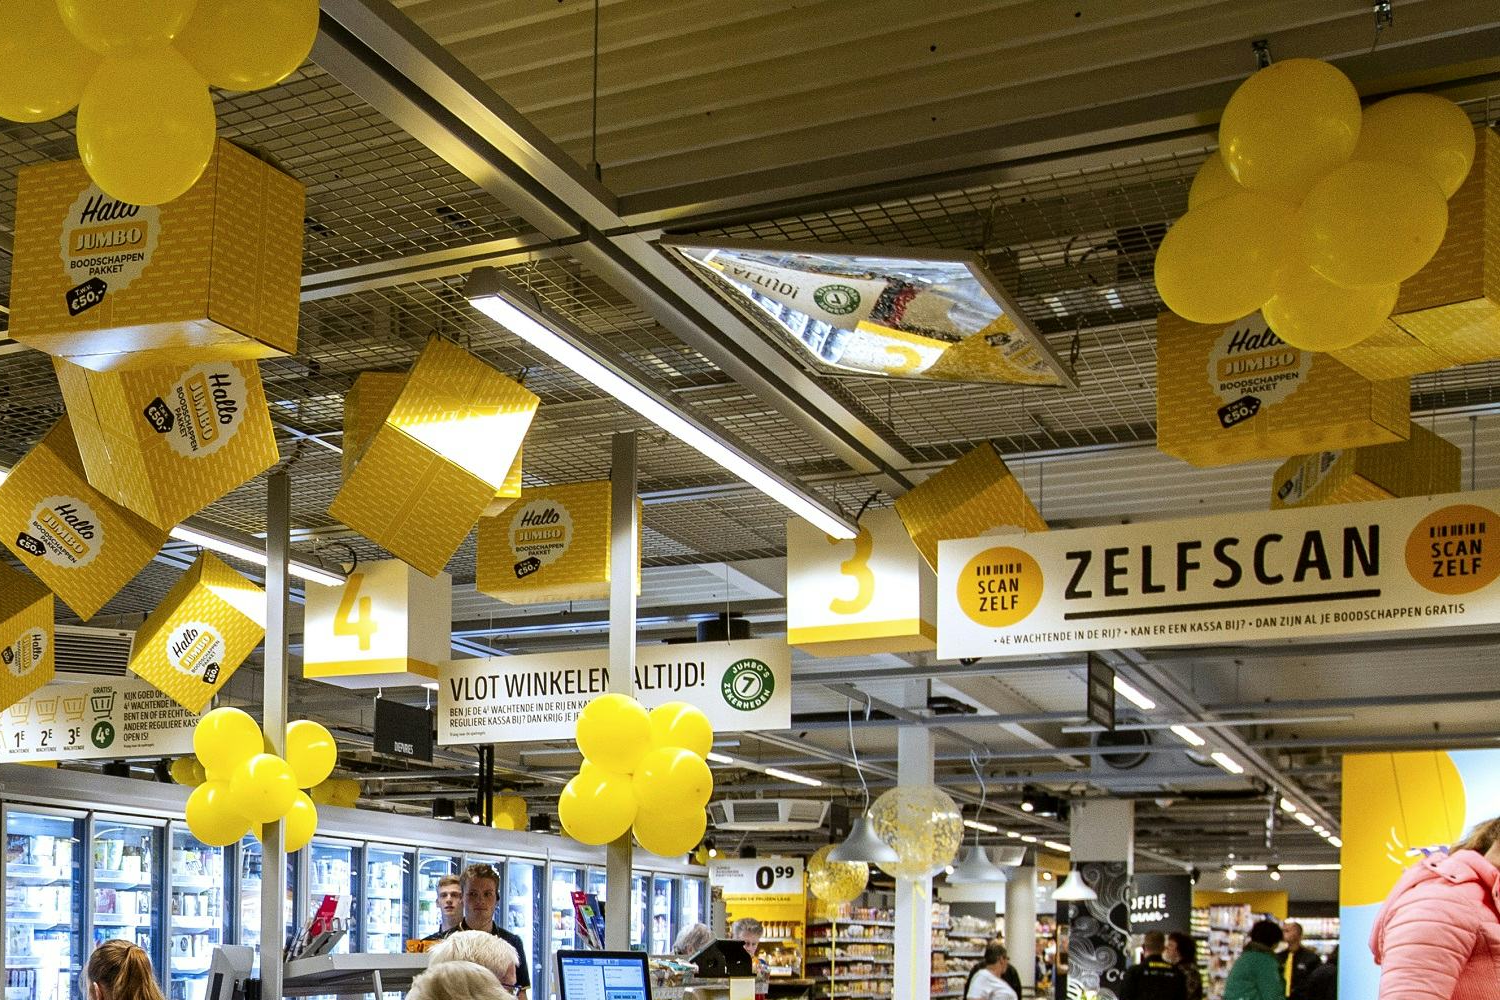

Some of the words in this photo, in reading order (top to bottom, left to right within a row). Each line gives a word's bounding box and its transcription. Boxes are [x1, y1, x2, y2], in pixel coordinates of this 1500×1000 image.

[80, 194, 140, 224] Hallo
[75, 227, 143, 251] JUMBO
[70, 252, 144, 269] BOODSCHAPPEN
[89, 264, 124, 276] PAKKET
[71, 290, 103, 310] €50,-
[1226, 353, 1296, 376] JUMBO
[1220, 371, 1299, 391] BOODSCHAPPEN
[1241, 383, 1277, 394] PAKKET
[209, 373, 238, 425] Hallo
[148, 407, 167, 430] €50,-
[176, 386, 198, 452] BOODSCHAPPEN
[189, 382, 213, 440] JUMBO
[1224, 405, 1257, 423] €50,-
[175, 408, 187, 438] PAKKET
[54, 504, 94, 539] Hallo
[521, 508, 560, 527] Hallo
[32, 521, 77, 563] BOODSCHAPPEN
[42, 512, 84, 553] JUMBO
[517, 529, 562, 542] JUMBO
[41, 536, 62, 556] PAKKET
[516, 543, 564, 552] BOODSCHAPPEN
[1431, 539, 1483, 559] SCAN
[826, 525, 875, 615] 3
[1064, 524, 1380, 600] ZELFSCAN
[1433, 558, 1482, 578] ZELF
[978, 578, 1020, 595] SCAN
[334, 573, 377, 651] 4
[979, 594, 1020, 612] ZELF
[1000, 635, 1011, 645] 4E
[1013, 631, 1071, 644] WACHTENDE
[1074, 630, 1084, 640] IN
[1087, 629, 1099, 639] DE
[1102, 628, 1121, 639] RIJ?
[1131, 626, 1150, 636] KAN
[1153, 625, 1165, 635] ER
[1168, 623, 1187, 634] EEN
[1190, 621, 1223, 632] KASSA
[1225, 619, 1246, 631] BIJ?
[1256, 617, 1277, 628] DAN
[1280, 614, 1302, 627] ZIJN
[1304, 614, 1317, 624] AL
[1320, 613, 1331, 625] JE
[1334, 607, 1422, 622] BOODSCHAPPEN
[1425, 603, 1466, 616] GRATIS
[172, 629, 199, 658] Hallo
[732, 662, 770, 678] JUMBO'S
[93, 686, 112, 694] GRATIS!
[450, 675, 500, 702] VLOT
[504, 667, 610, 697] WINKELEN
[635, 662, 706, 692] ALTIJD!
[741, 676, 754, 694] 7
[124, 691, 137, 700] KIJK
[138, 691, 154, 699] GOED
[131, 700, 169, 710] WACHTENDE
[723, 682, 771, 709] ZEKERHEDEN
[124, 711, 140, 720] BENT
[140, 711, 149, 720] EN
[149, 711, 157, 719] OF
[159, 710, 167, 718] ER
[168, 709, 184, 718] ECHT
[450, 707, 464, 717] BEN
[465, 707, 473, 717] JE
[473, 706, 482, 715] DE
[491, 703, 535, 714] WACHTENDE
[535, 702, 544, 712] IN
[545, 702, 553, 711] DE
[555, 701, 566, 711] RIJ
[567, 701, 576, 710] EN
[578, 700, 591, 708] KA
[124, 721, 148, 732] ANDERE
[149, 719, 182, 730] REGULIERE
[183, 718, 199, 728] KASS
[450, 717, 487, 728] REGULIERE
[487, 716, 511, 726] KASSA
[511, 715, 526, 725] BIJ?
[526, 714, 541, 724] DAN
[543, 713, 563, 723] KRIJG
[564, 712, 572, 721] JE
[96, 726, 110, 744] 4e
[124, 733, 140, 741] OPEN
